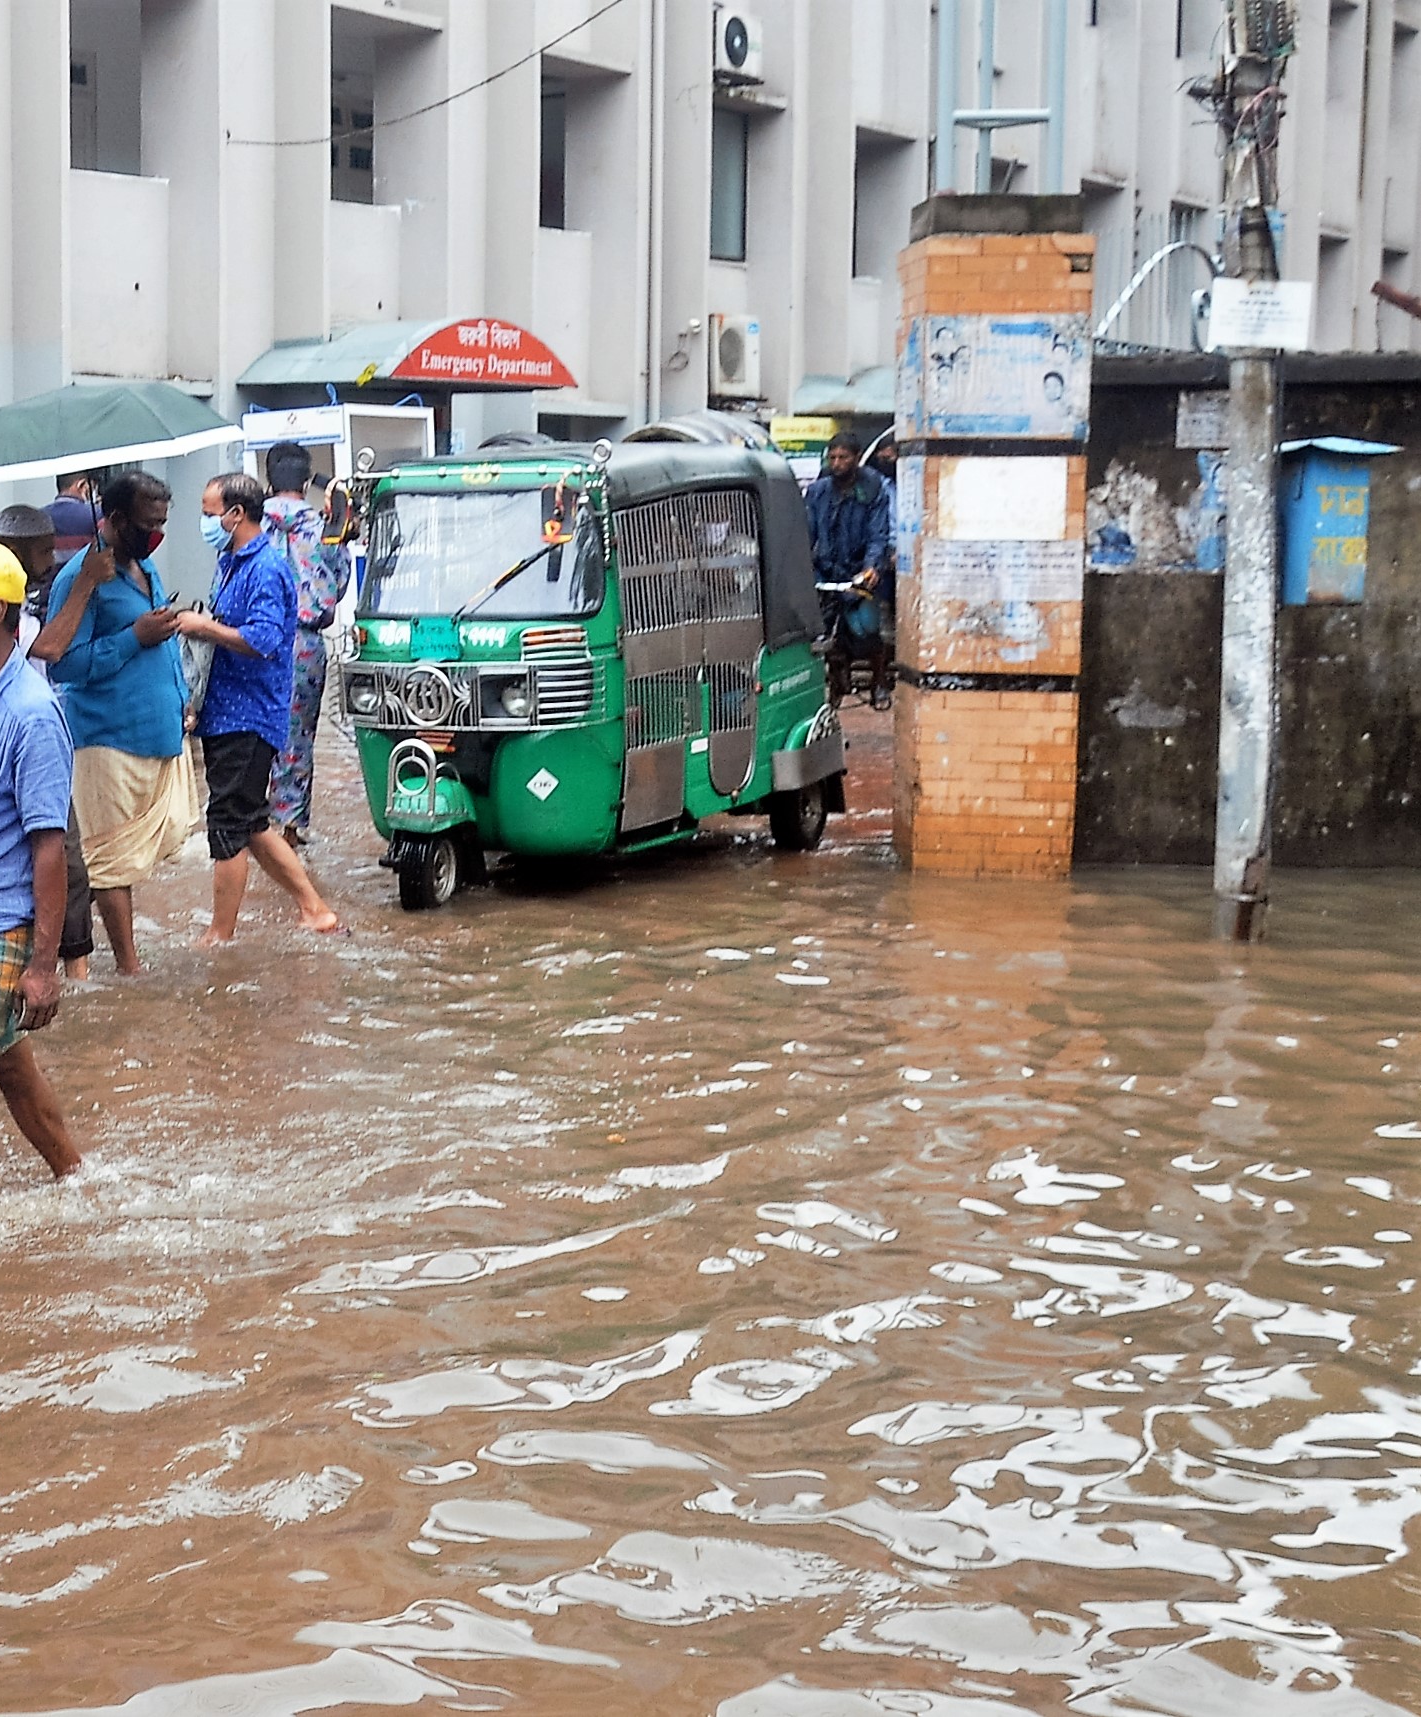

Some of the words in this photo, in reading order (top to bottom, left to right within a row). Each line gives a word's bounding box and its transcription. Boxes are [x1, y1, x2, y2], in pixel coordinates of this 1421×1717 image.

[490, 322, 522, 350] বিভাগ
[421, 349, 486, 378] Emergency
[488, 353, 553, 379] Department
[1316, 485, 1369, 516] দান
